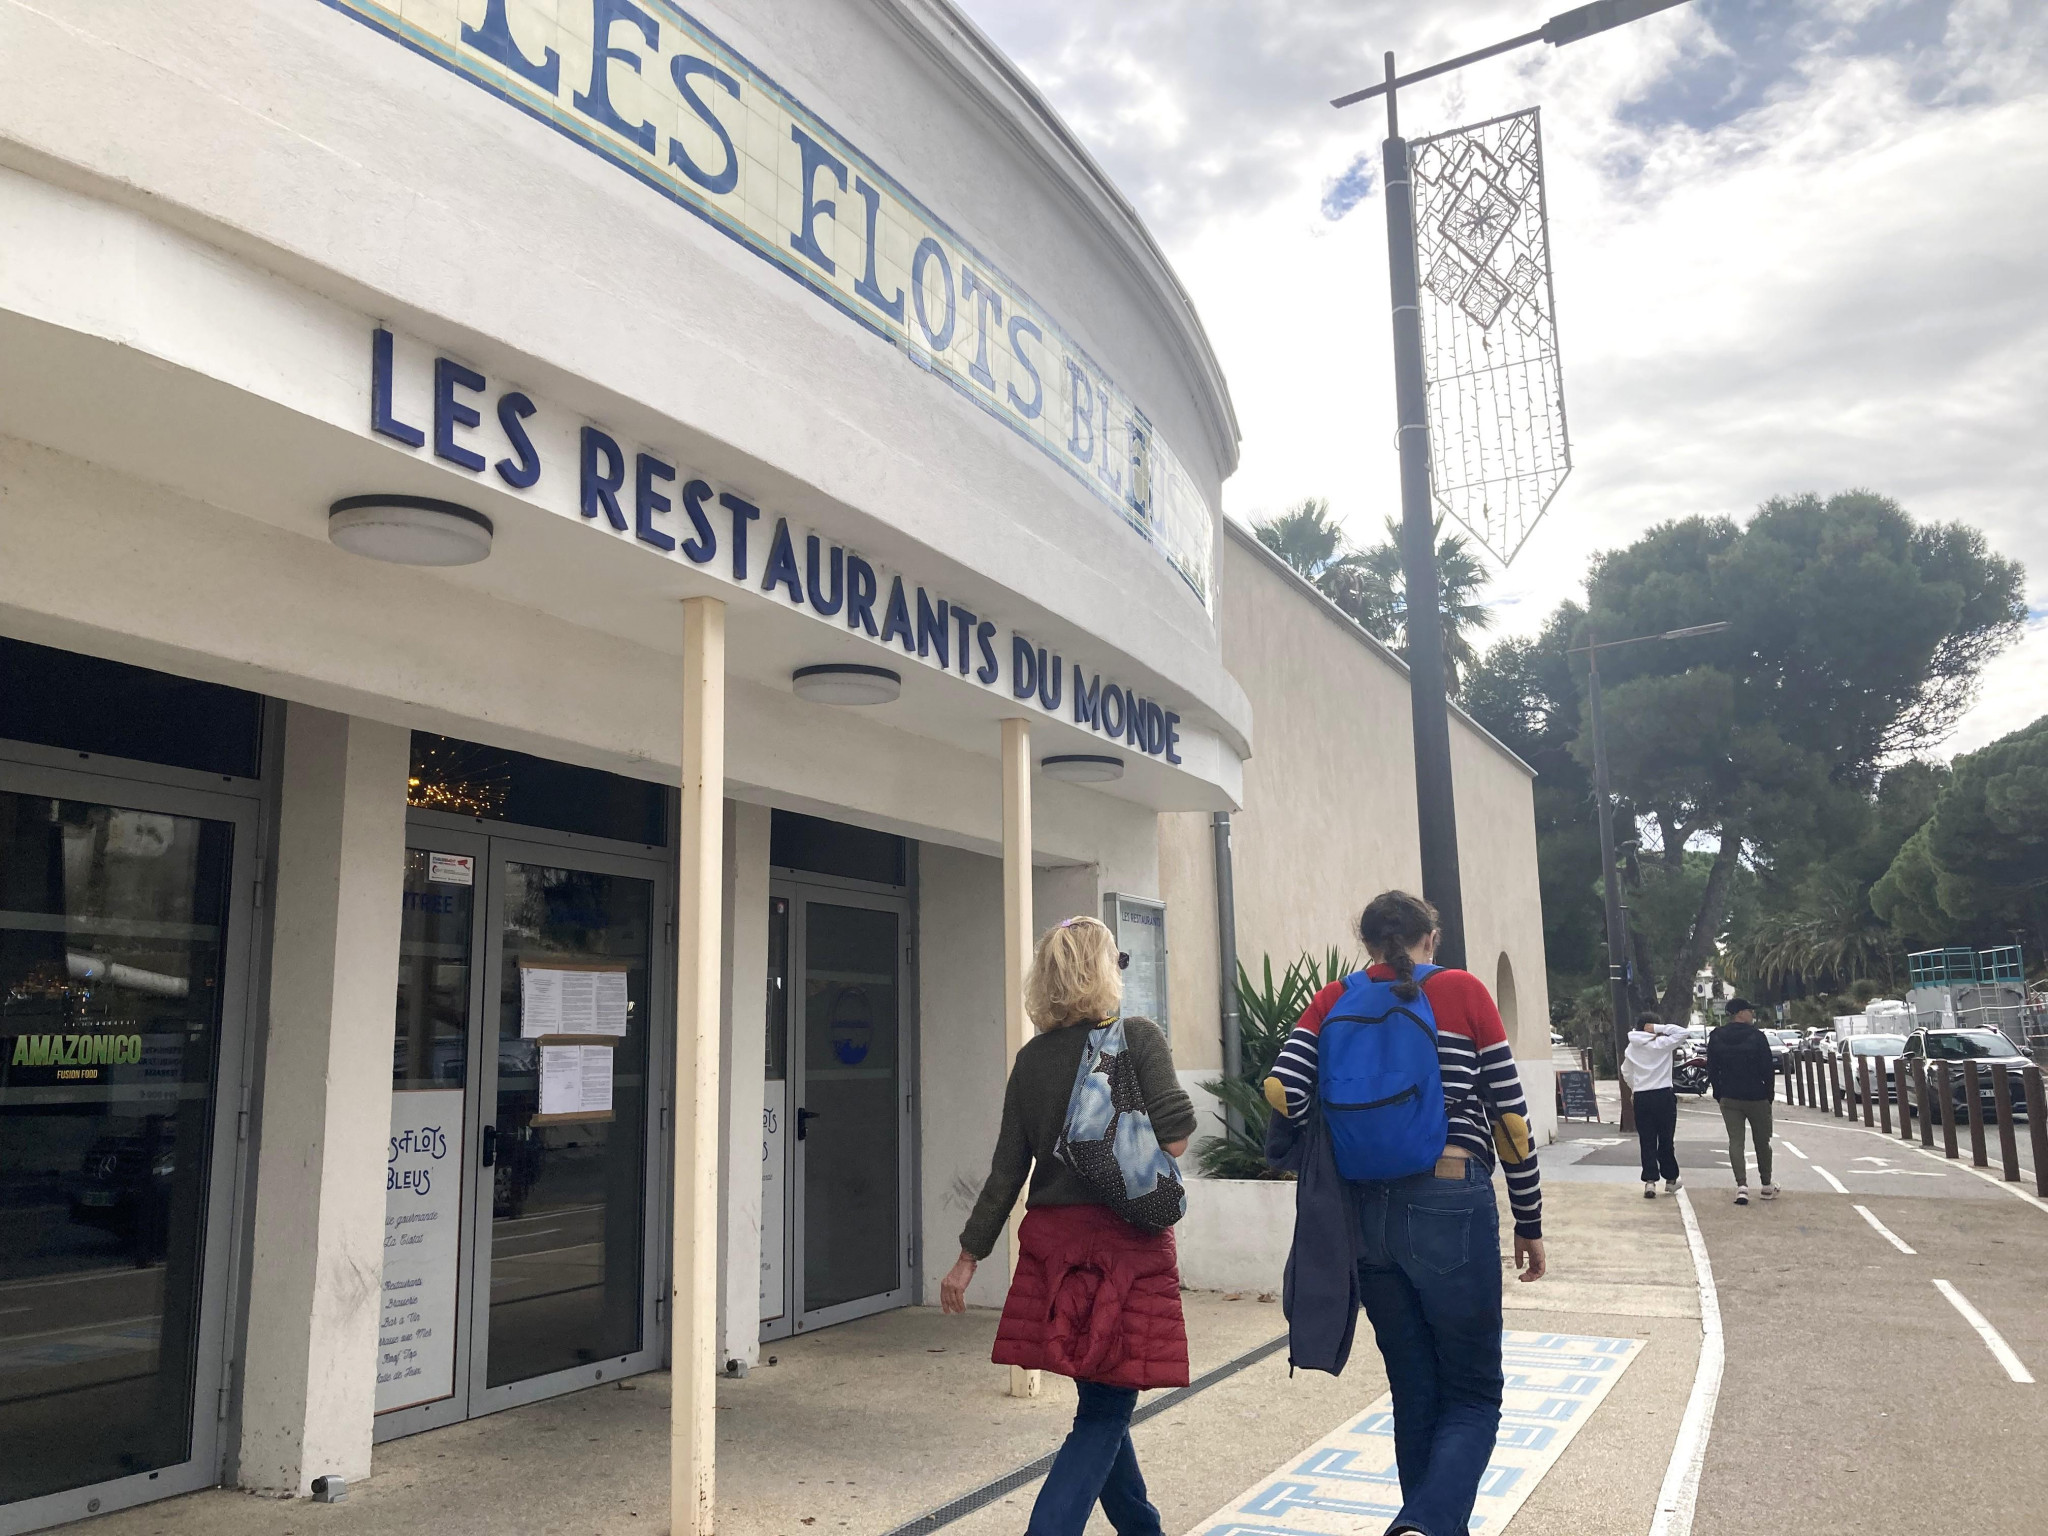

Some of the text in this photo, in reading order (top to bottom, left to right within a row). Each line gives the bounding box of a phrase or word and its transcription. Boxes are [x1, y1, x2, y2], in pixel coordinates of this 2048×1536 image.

[461, 0, 740, 194] LES
[789, 122, 1043, 420] FLOTS
[371, 327, 1182, 765] LES RESTAURANTS DU MONDE
[12, 1034, 142, 1066] AMAZONICO
[57, 1069, 98, 1079] FUSION FOOD
[387, 1167, 430, 1196] BLEUS
